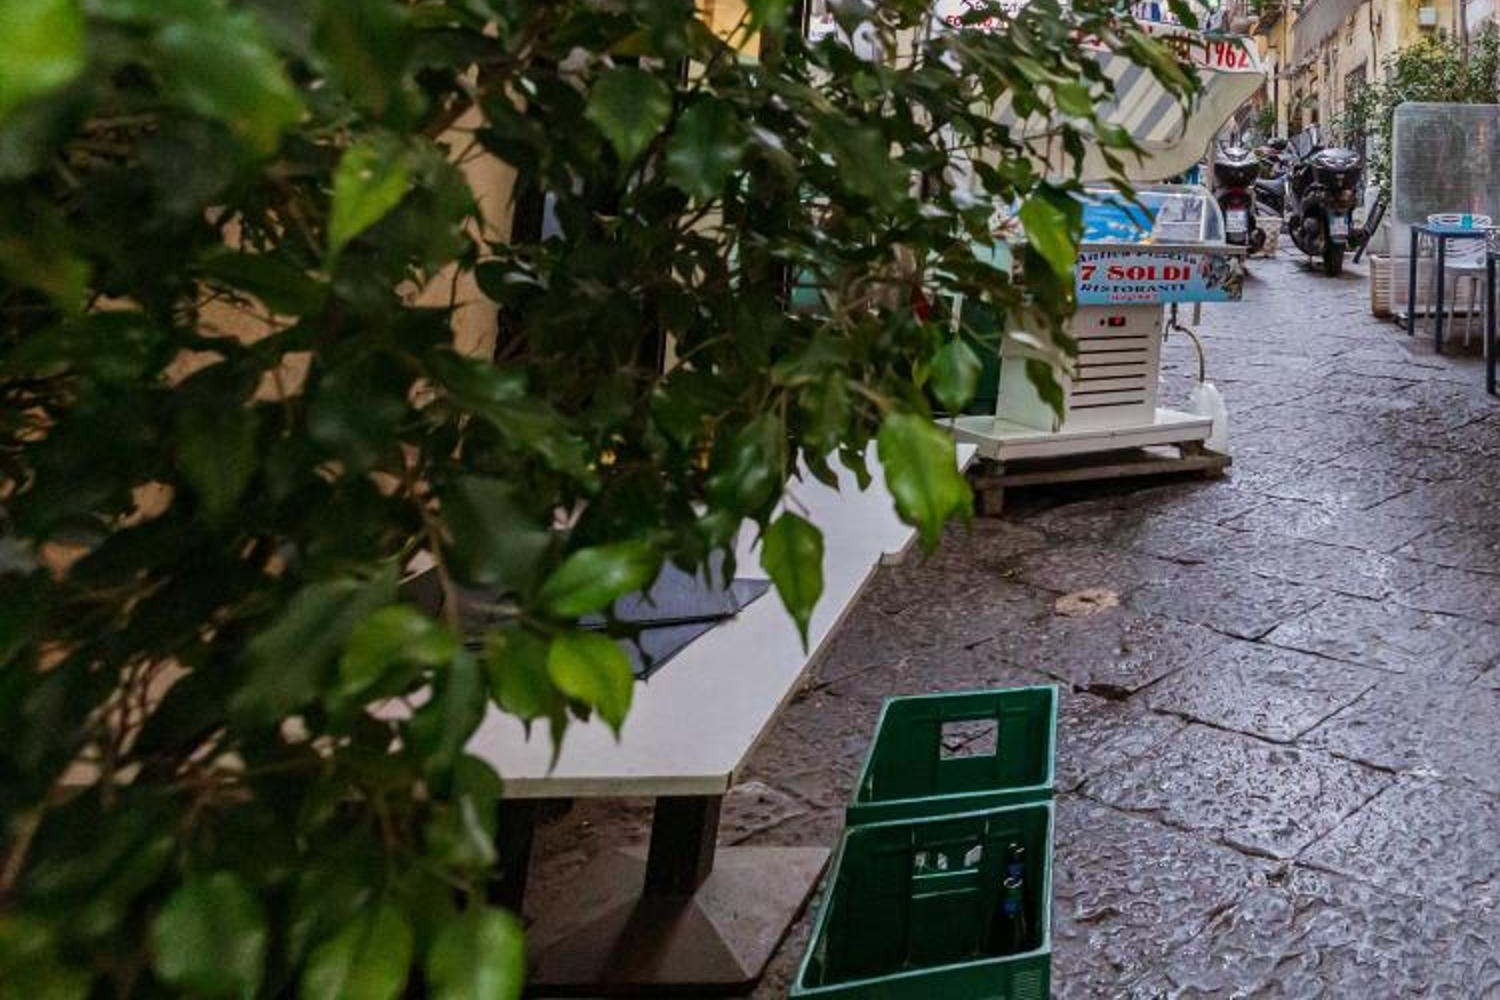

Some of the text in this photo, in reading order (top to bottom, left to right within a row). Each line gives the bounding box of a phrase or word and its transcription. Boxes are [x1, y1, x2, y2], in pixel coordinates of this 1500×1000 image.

[1205, 40, 1249, 69] 1962
[1081, 264, 1191, 281] 7 SOLDI
